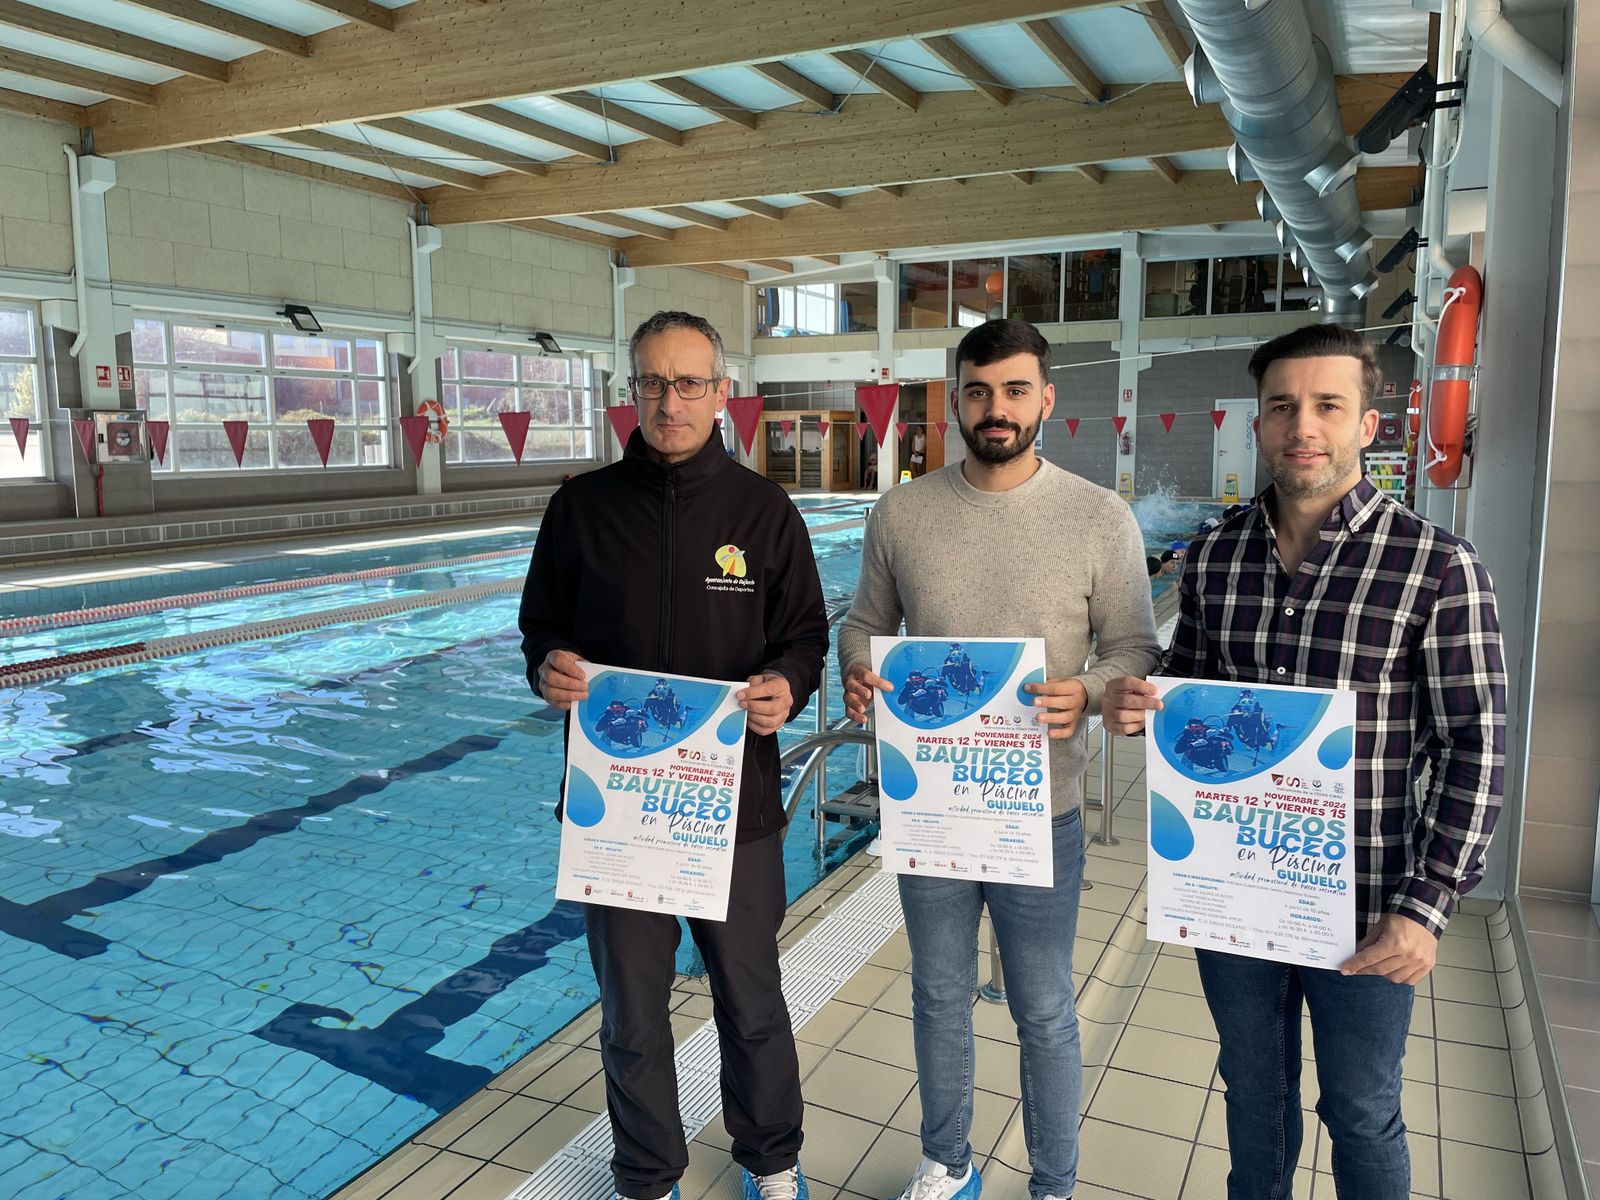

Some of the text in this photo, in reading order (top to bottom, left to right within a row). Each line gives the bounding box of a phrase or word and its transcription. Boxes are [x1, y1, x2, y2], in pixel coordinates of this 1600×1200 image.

[958, 737, 970, 745] 12
[915, 744, 1042, 767] BAUTIZOS
[610, 764, 648, 775] MARTES
[652, 768, 665, 777] 12
[678, 773, 718, 785] VIERNES
[722, 778, 734, 787] 15
[670, 764, 714, 775] NOVIEMBRE
[952, 764, 1043, 786] BUCEO
[607, 772, 733, 805] BAUTIZOS
[954, 778, 1040, 804] en Piscina
[642, 794, 732, 823] BUCEO
[987, 800, 1044, 812] GUIJUELO
[1195, 791, 1239, 803] MARTES
[1244, 796, 1258, 806] 12
[1276, 802, 1325, 816] VIERNES
[1330, 809, 1346, 819] 15
[1264, 792, 1346, 809] NOVIEMBRE 2024
[642, 809, 726, 840] en Piscina
[1193, 800, 1346, 840] BAUTIZOS
[673, 832, 728, 848] GUIJUELO
[1236, 826, 1346, 860] BUCEO
[1238, 845, 1341, 876] en Piscina
[1277, 869, 1347, 890] GUIJUELO
